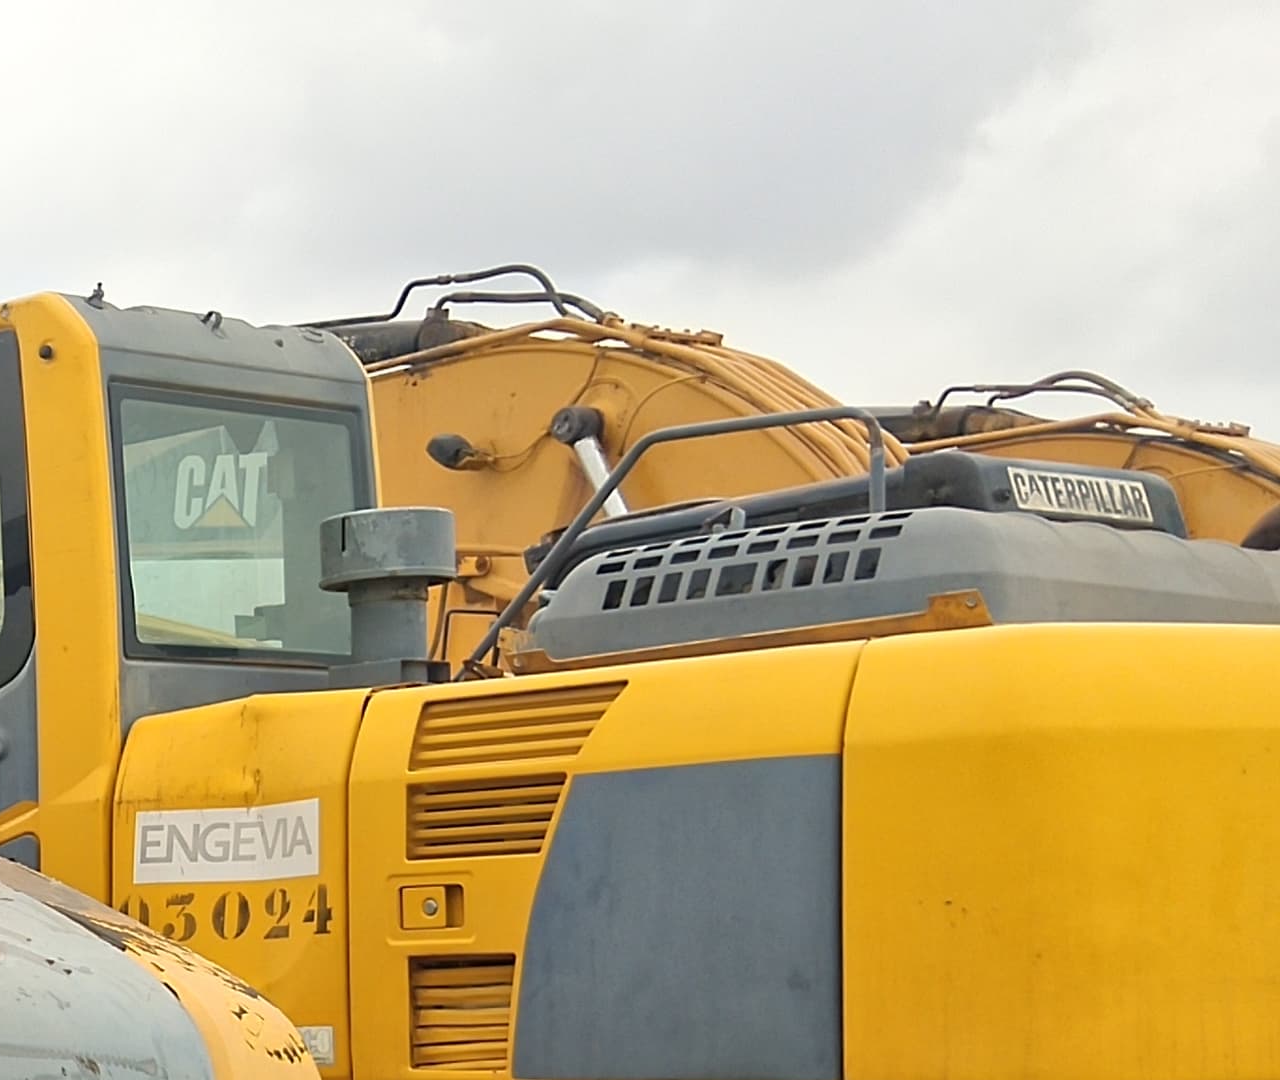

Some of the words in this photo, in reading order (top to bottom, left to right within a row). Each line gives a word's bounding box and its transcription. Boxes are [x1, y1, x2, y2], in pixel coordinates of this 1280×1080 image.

[173, 452, 268, 530] CAT
[1013, 471, 1150, 519] CATERPILLAR
[140, 815, 313, 865] ENGEVIA
